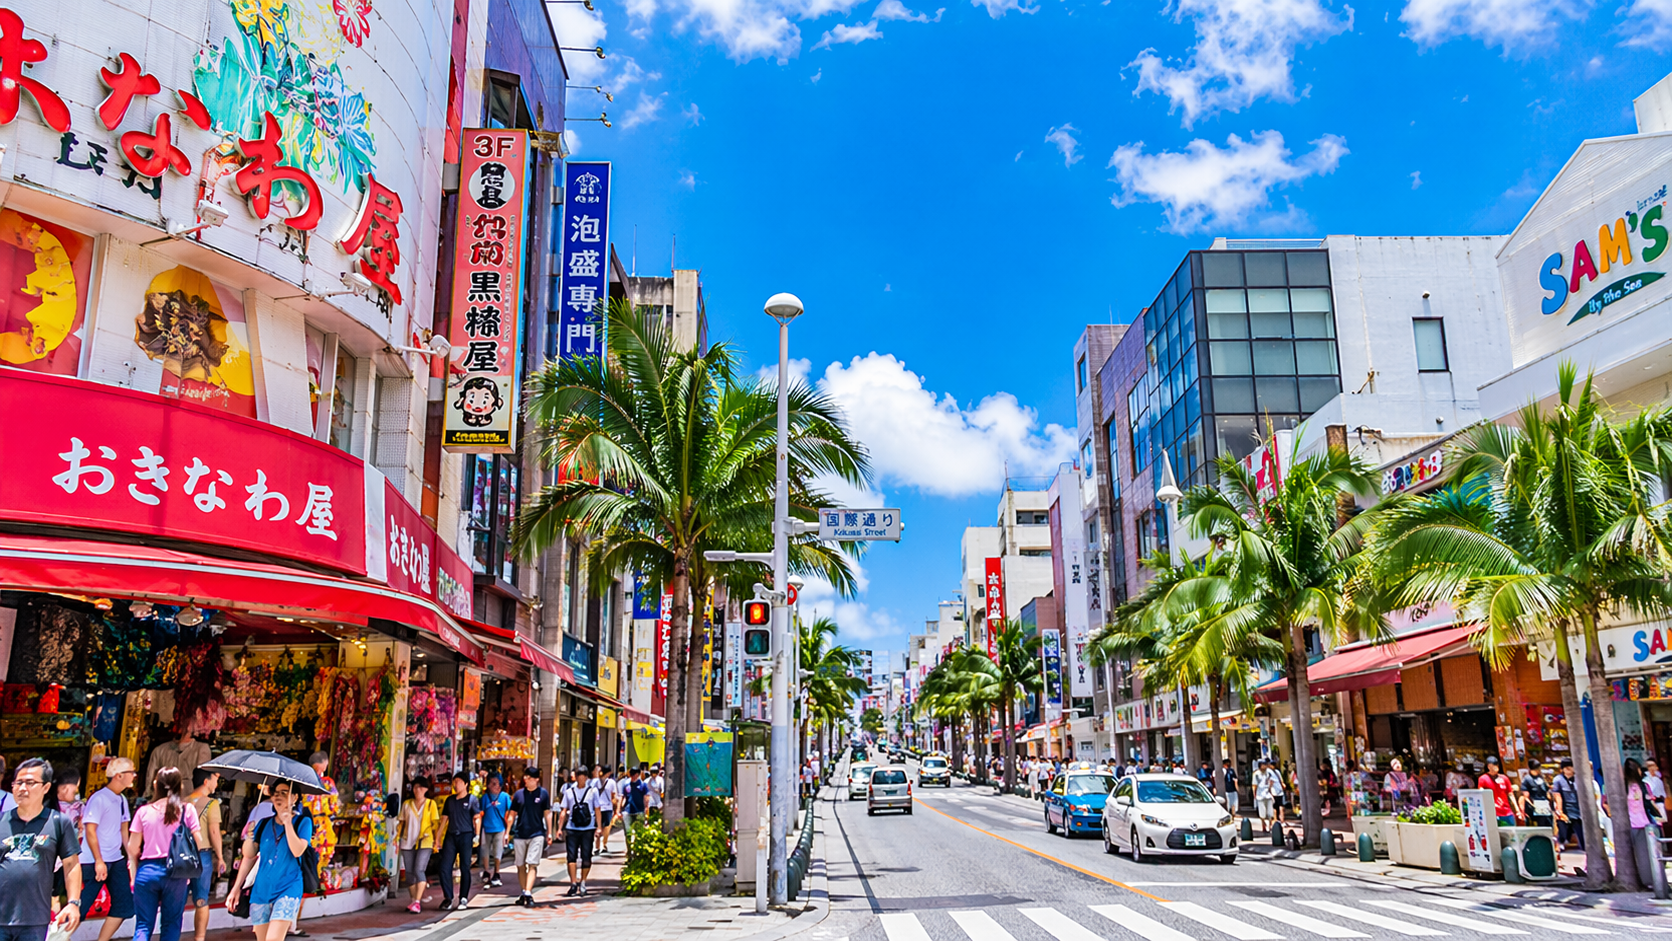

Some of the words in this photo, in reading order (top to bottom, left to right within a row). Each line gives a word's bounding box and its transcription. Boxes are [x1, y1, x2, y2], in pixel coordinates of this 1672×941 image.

[473, 133, 516, 158] 3F
[566, 214, 602, 354] 泡盛専門
[1539, 204, 1669, 316] SAM'S
[52, 437, 338, 542] おきなわ屋
[826, 512, 893, 527] 国際通り
